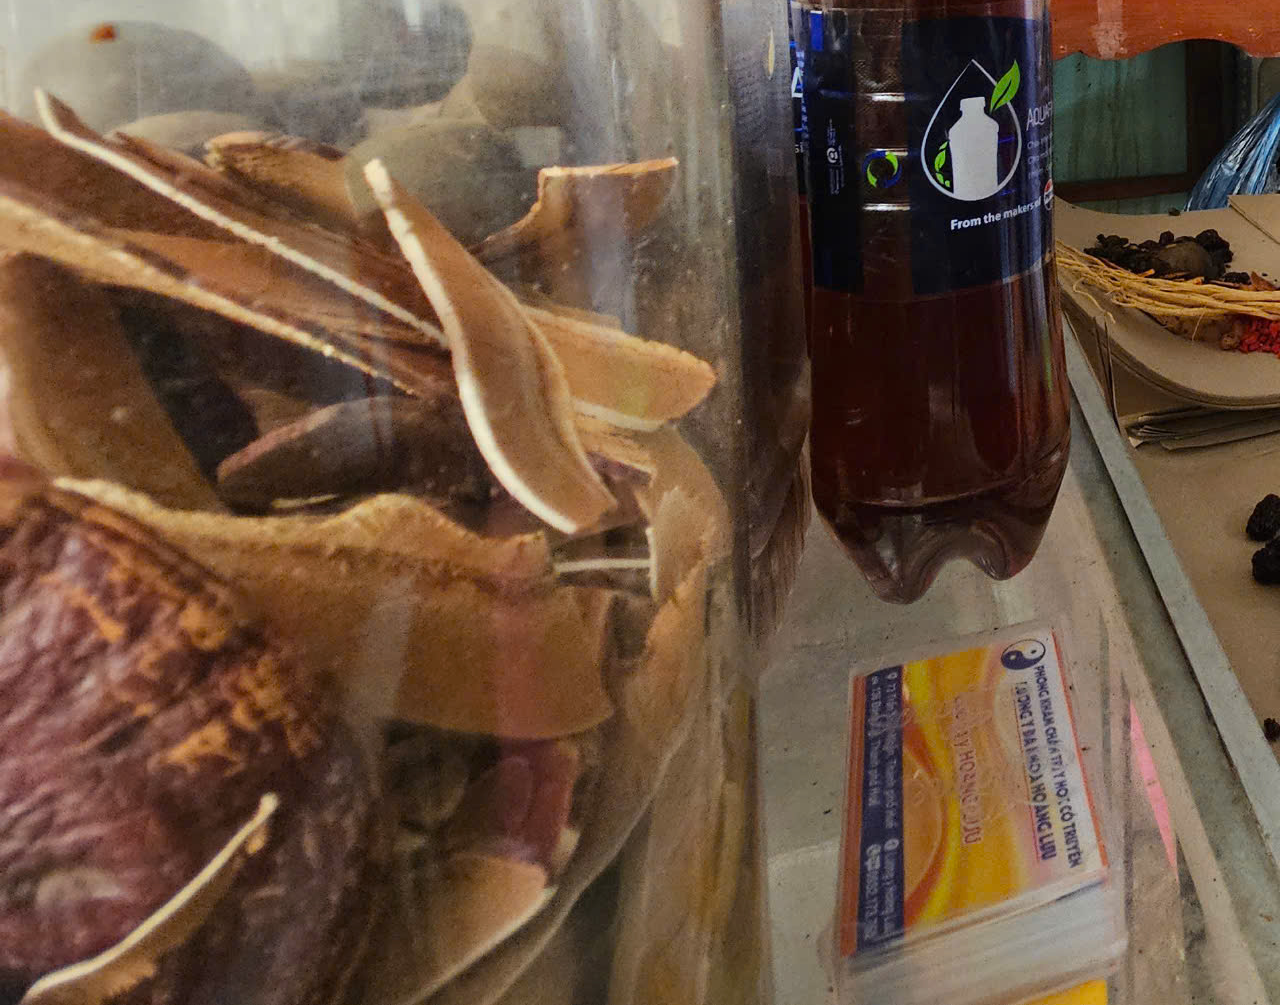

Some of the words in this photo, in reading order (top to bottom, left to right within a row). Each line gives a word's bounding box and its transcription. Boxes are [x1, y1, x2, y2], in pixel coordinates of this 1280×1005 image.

[951, 216, 982, 231] From
[983, 212, 1002, 225] the
[1003, 201, 1035, 220] makers
